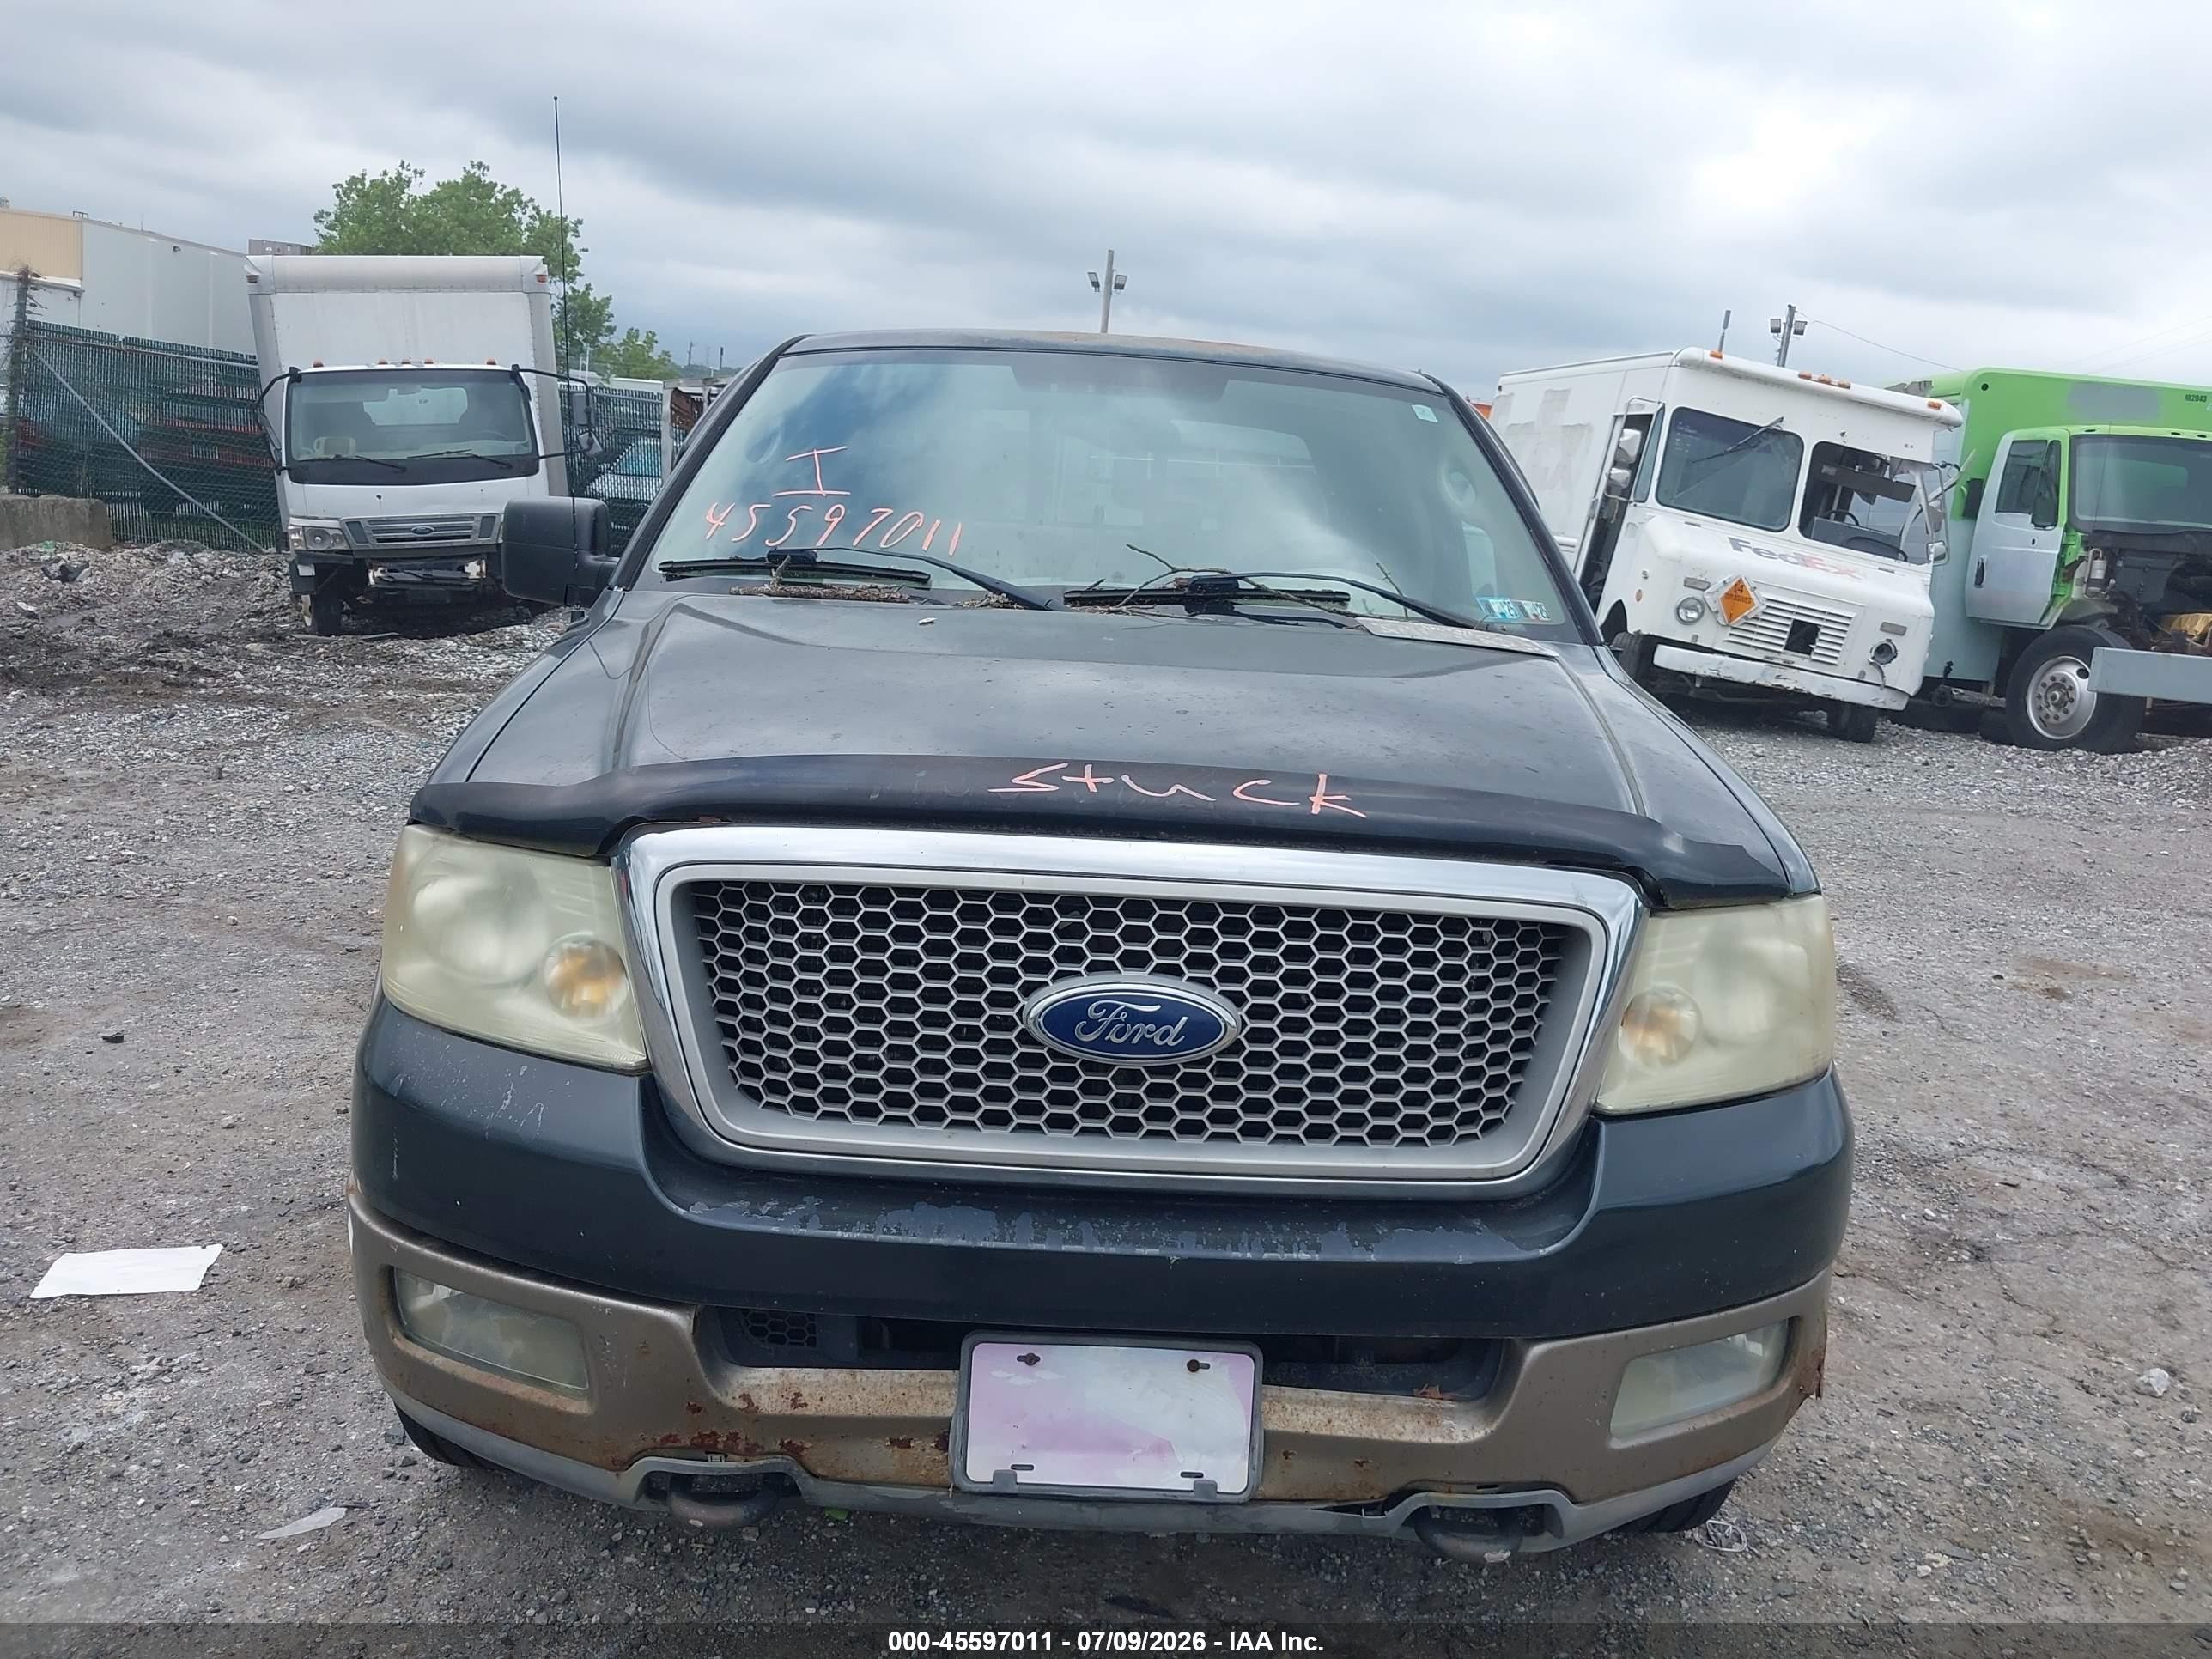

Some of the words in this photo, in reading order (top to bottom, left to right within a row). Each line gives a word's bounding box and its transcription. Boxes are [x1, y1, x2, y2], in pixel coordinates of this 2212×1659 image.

[705, 502, 963, 556] 45597011
[1728, 536, 1863, 580] FedEx
[1074, 999, 1190, 1048] Ford
